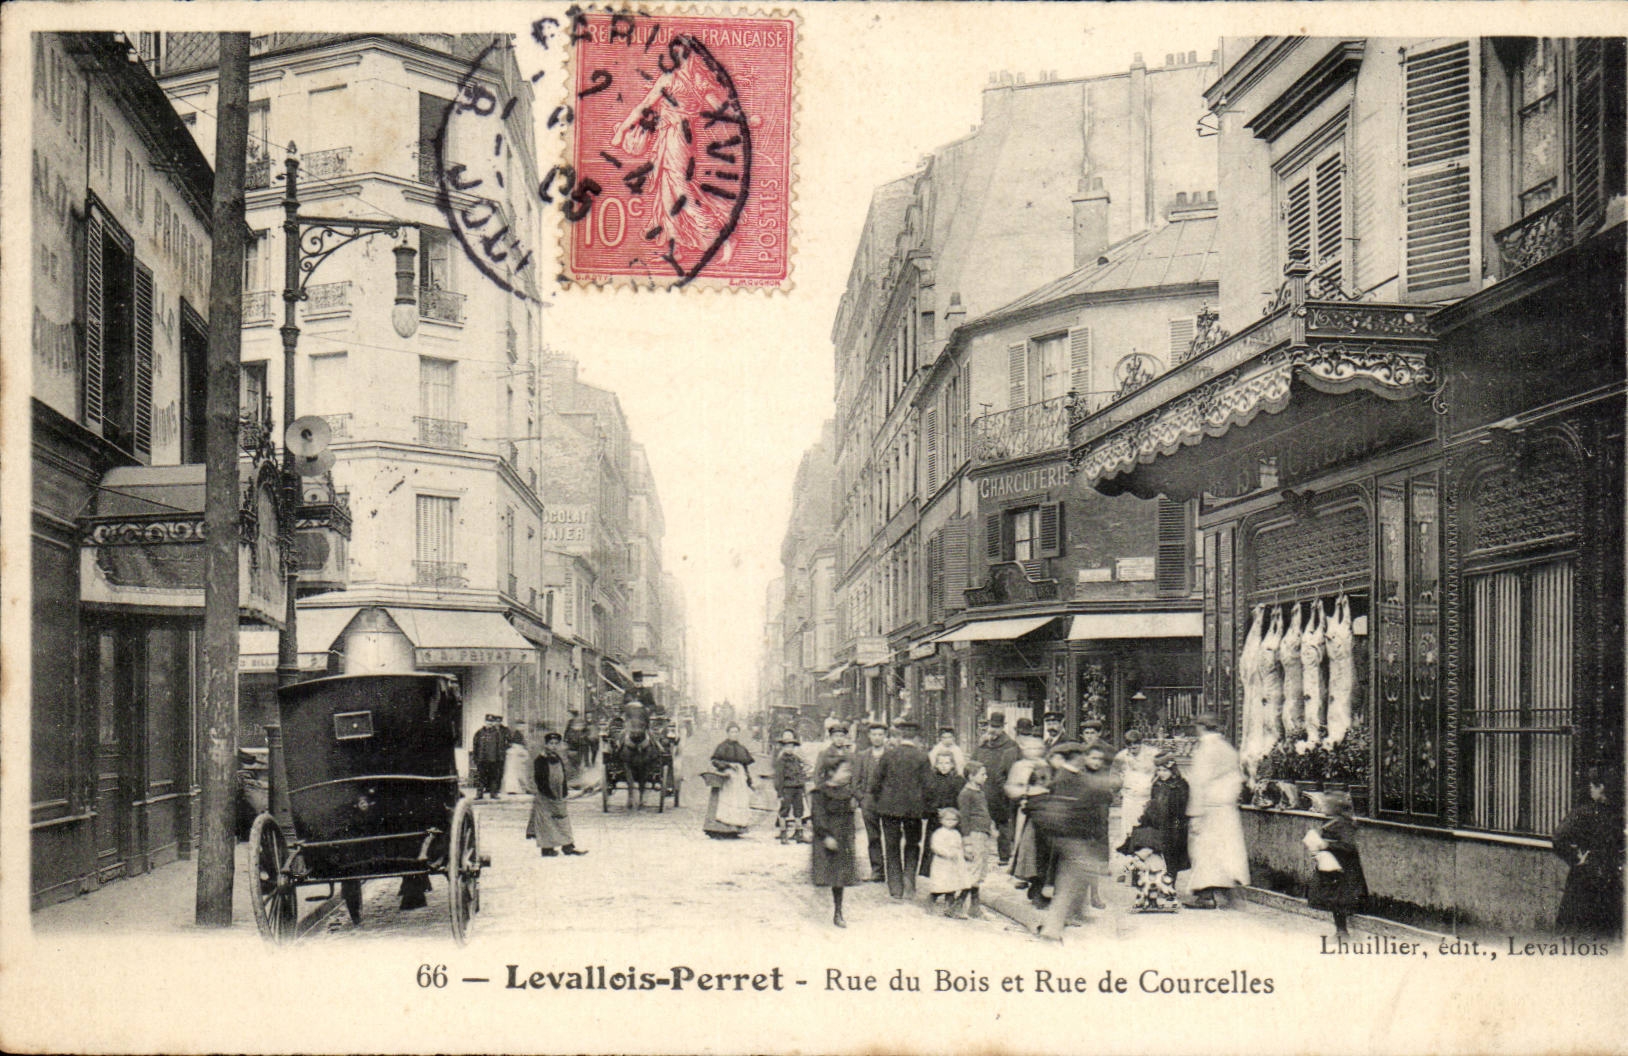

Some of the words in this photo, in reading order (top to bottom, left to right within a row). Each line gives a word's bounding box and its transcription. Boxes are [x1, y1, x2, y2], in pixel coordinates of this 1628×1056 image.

[702, 28, 784, 49] FRANÇAISE
[758, 179, 779, 263] POSTES
[980, 463, 1070, 498] CHARCUTERIE
